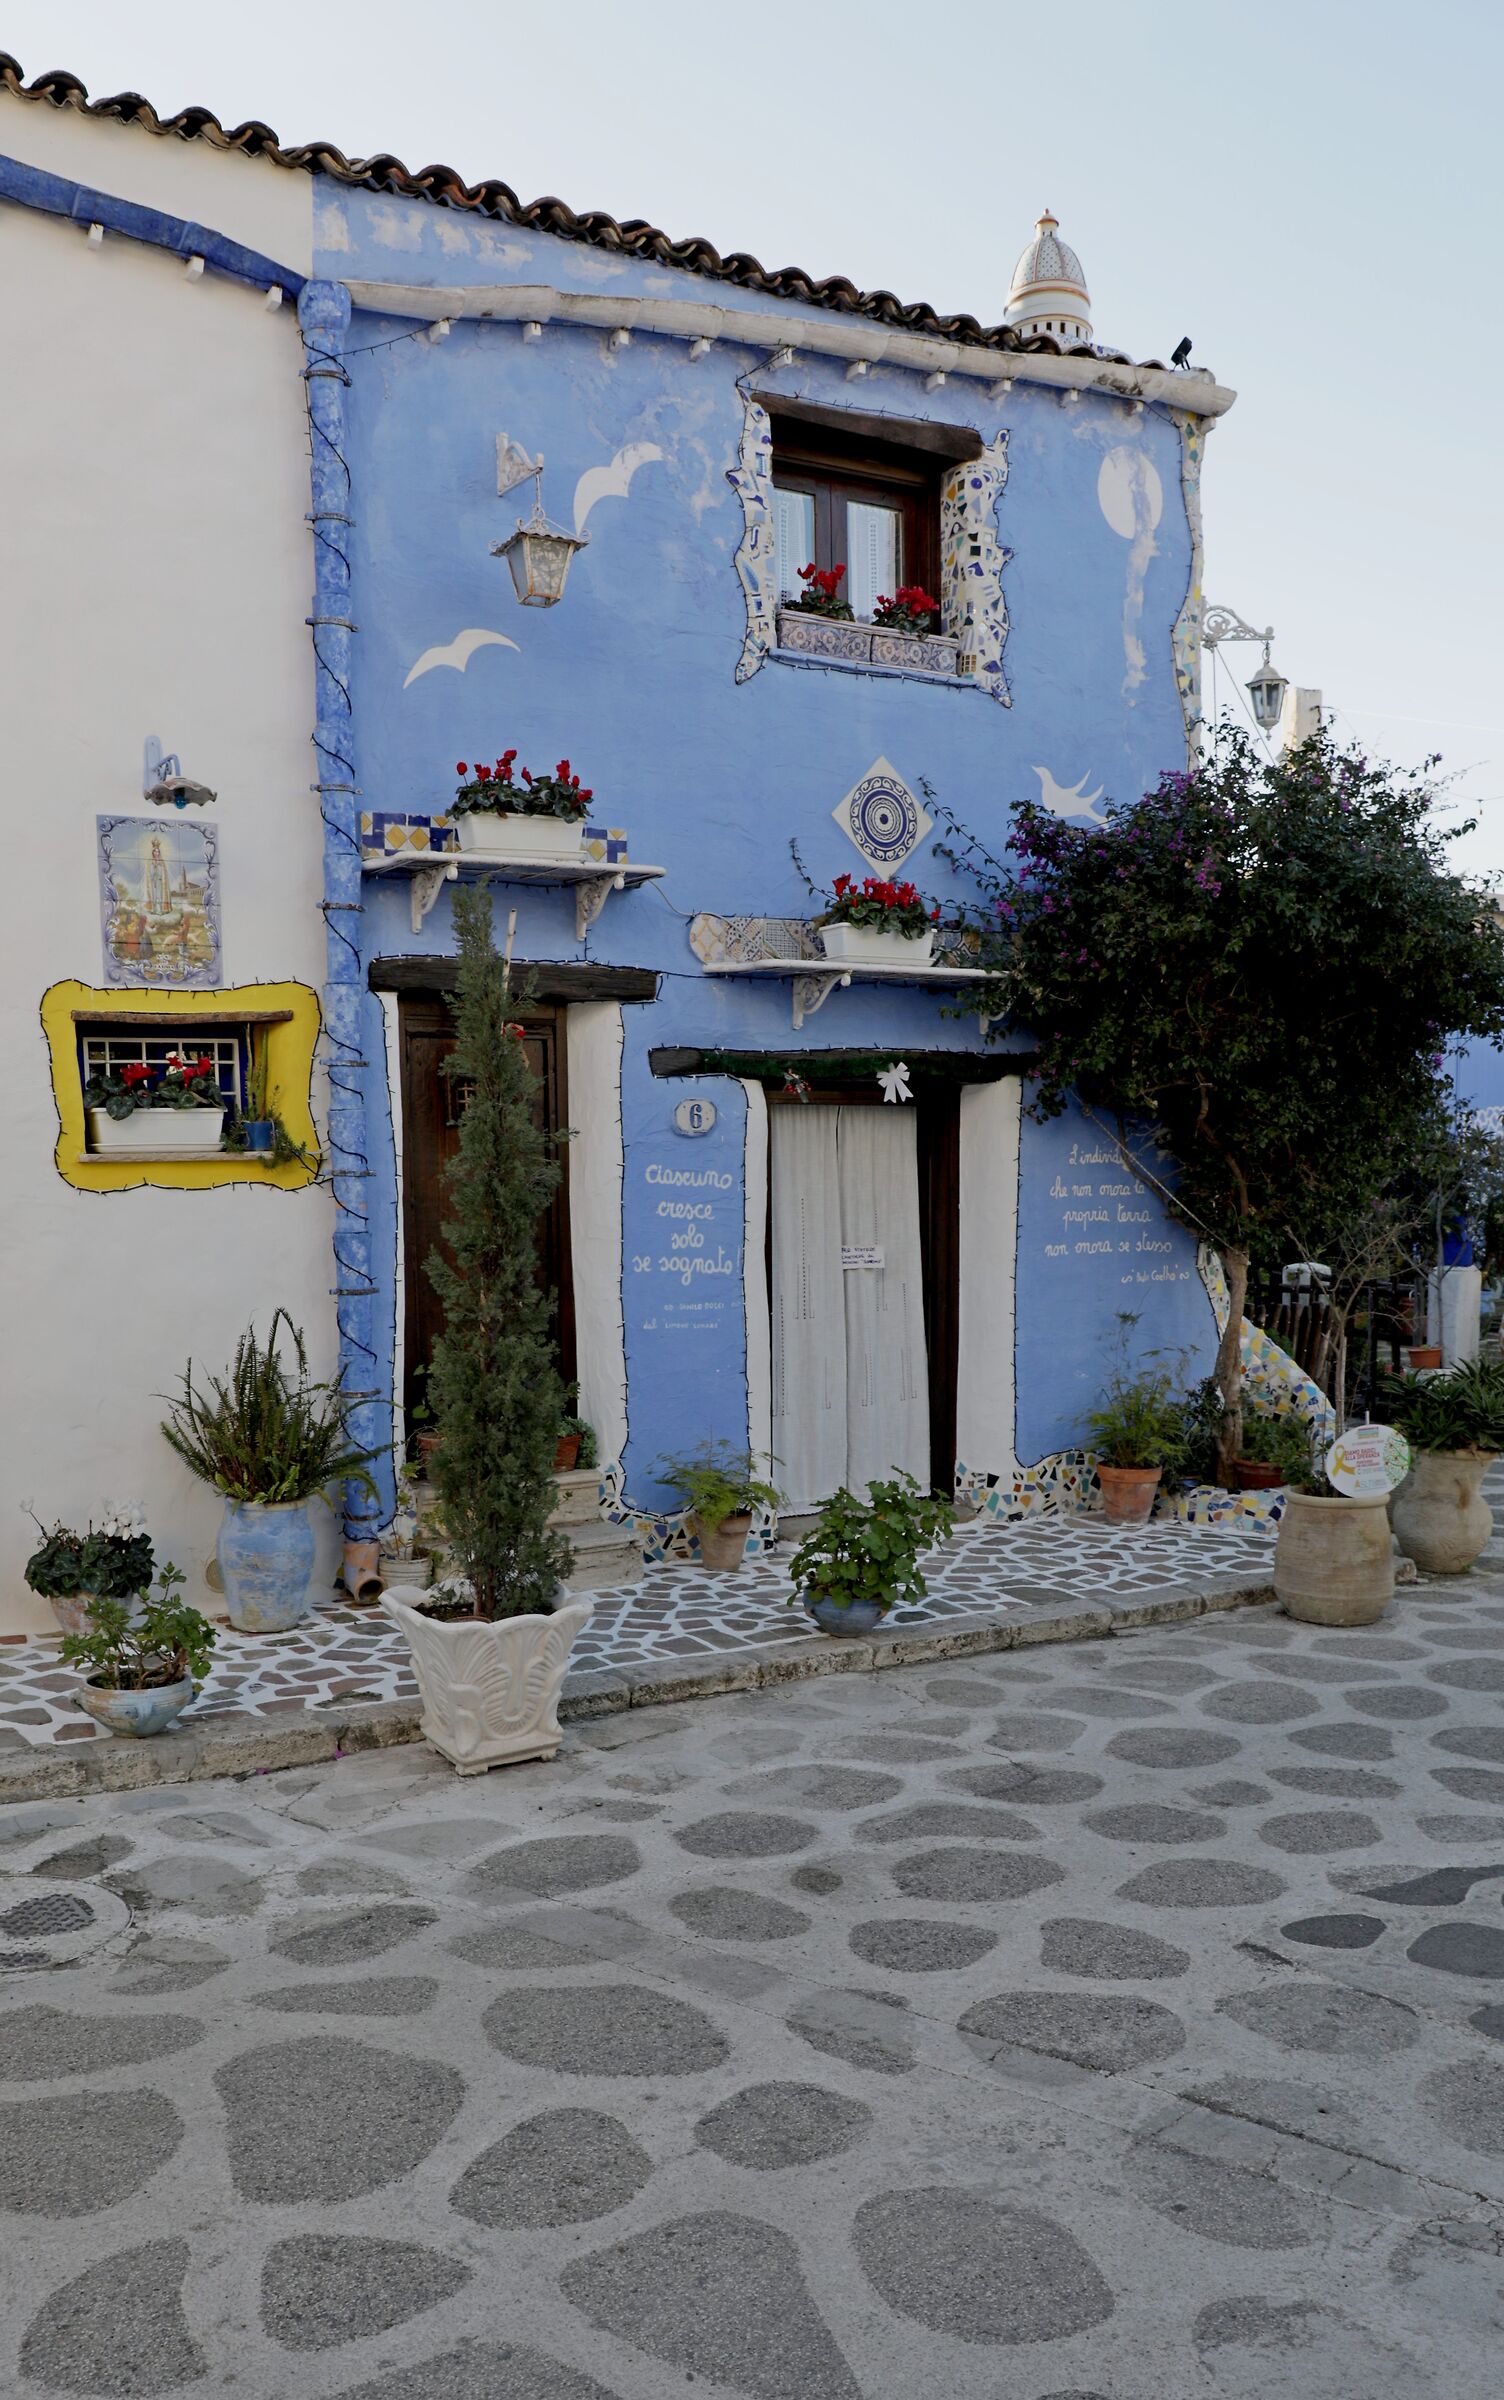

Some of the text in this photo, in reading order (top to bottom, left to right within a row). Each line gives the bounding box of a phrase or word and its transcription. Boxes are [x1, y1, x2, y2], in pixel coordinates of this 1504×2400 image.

[690, 1104, 702, 1129] 6
[645, 1164, 733, 1190] Ciascuno
[1050, 1175, 1146, 1199] che non onora la
[656, 1200, 715, 1220] cresce
[1062, 1203, 1152, 1232] propria terra
[671, 1223, 705, 1250] solo
[1045, 1231, 1173, 1257] non onora se stesso
[632, 1255, 652, 1273] se
